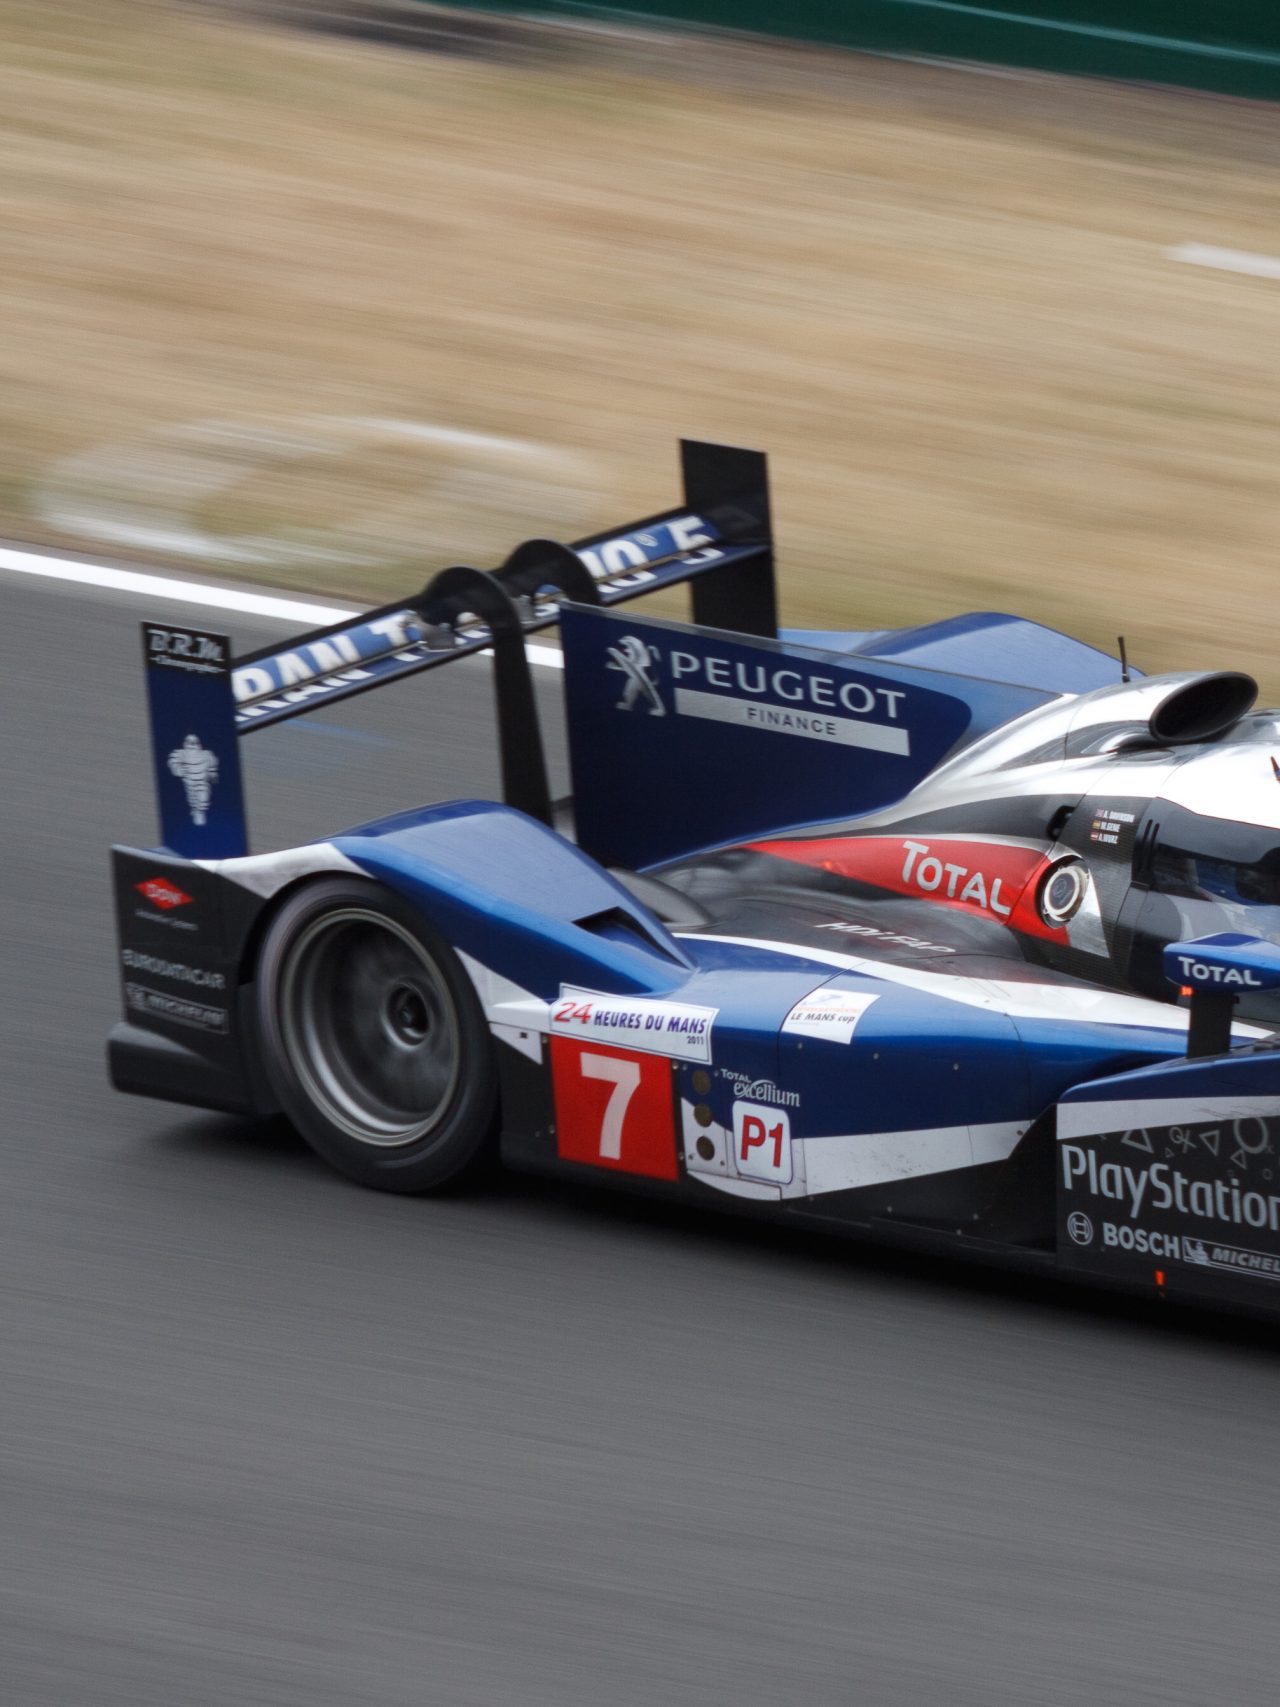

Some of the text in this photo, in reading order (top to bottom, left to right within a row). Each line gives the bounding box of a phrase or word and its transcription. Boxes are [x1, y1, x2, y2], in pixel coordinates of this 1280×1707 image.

[669, 650, 906, 720] PEUGEOT
[747, 707, 838, 737] FINANCE
[901, 839, 1012, 917] TOTAL
[1177, 955, 1263, 986] TOTAL
[553, 1001, 708, 1035] 24 HEURES DU MANS
[790, 1011, 856, 1024] LE MANS cup
[686, 1035, 705, 1045] 2011
[719, 1068, 752, 1084] TOTAL
[579, 1051, 642, 1160] 7
[733, 1078, 801, 1107] excellium
[740, 1114, 785, 1168] P1
[1102, 1222, 1181, 1260] BOSCH
